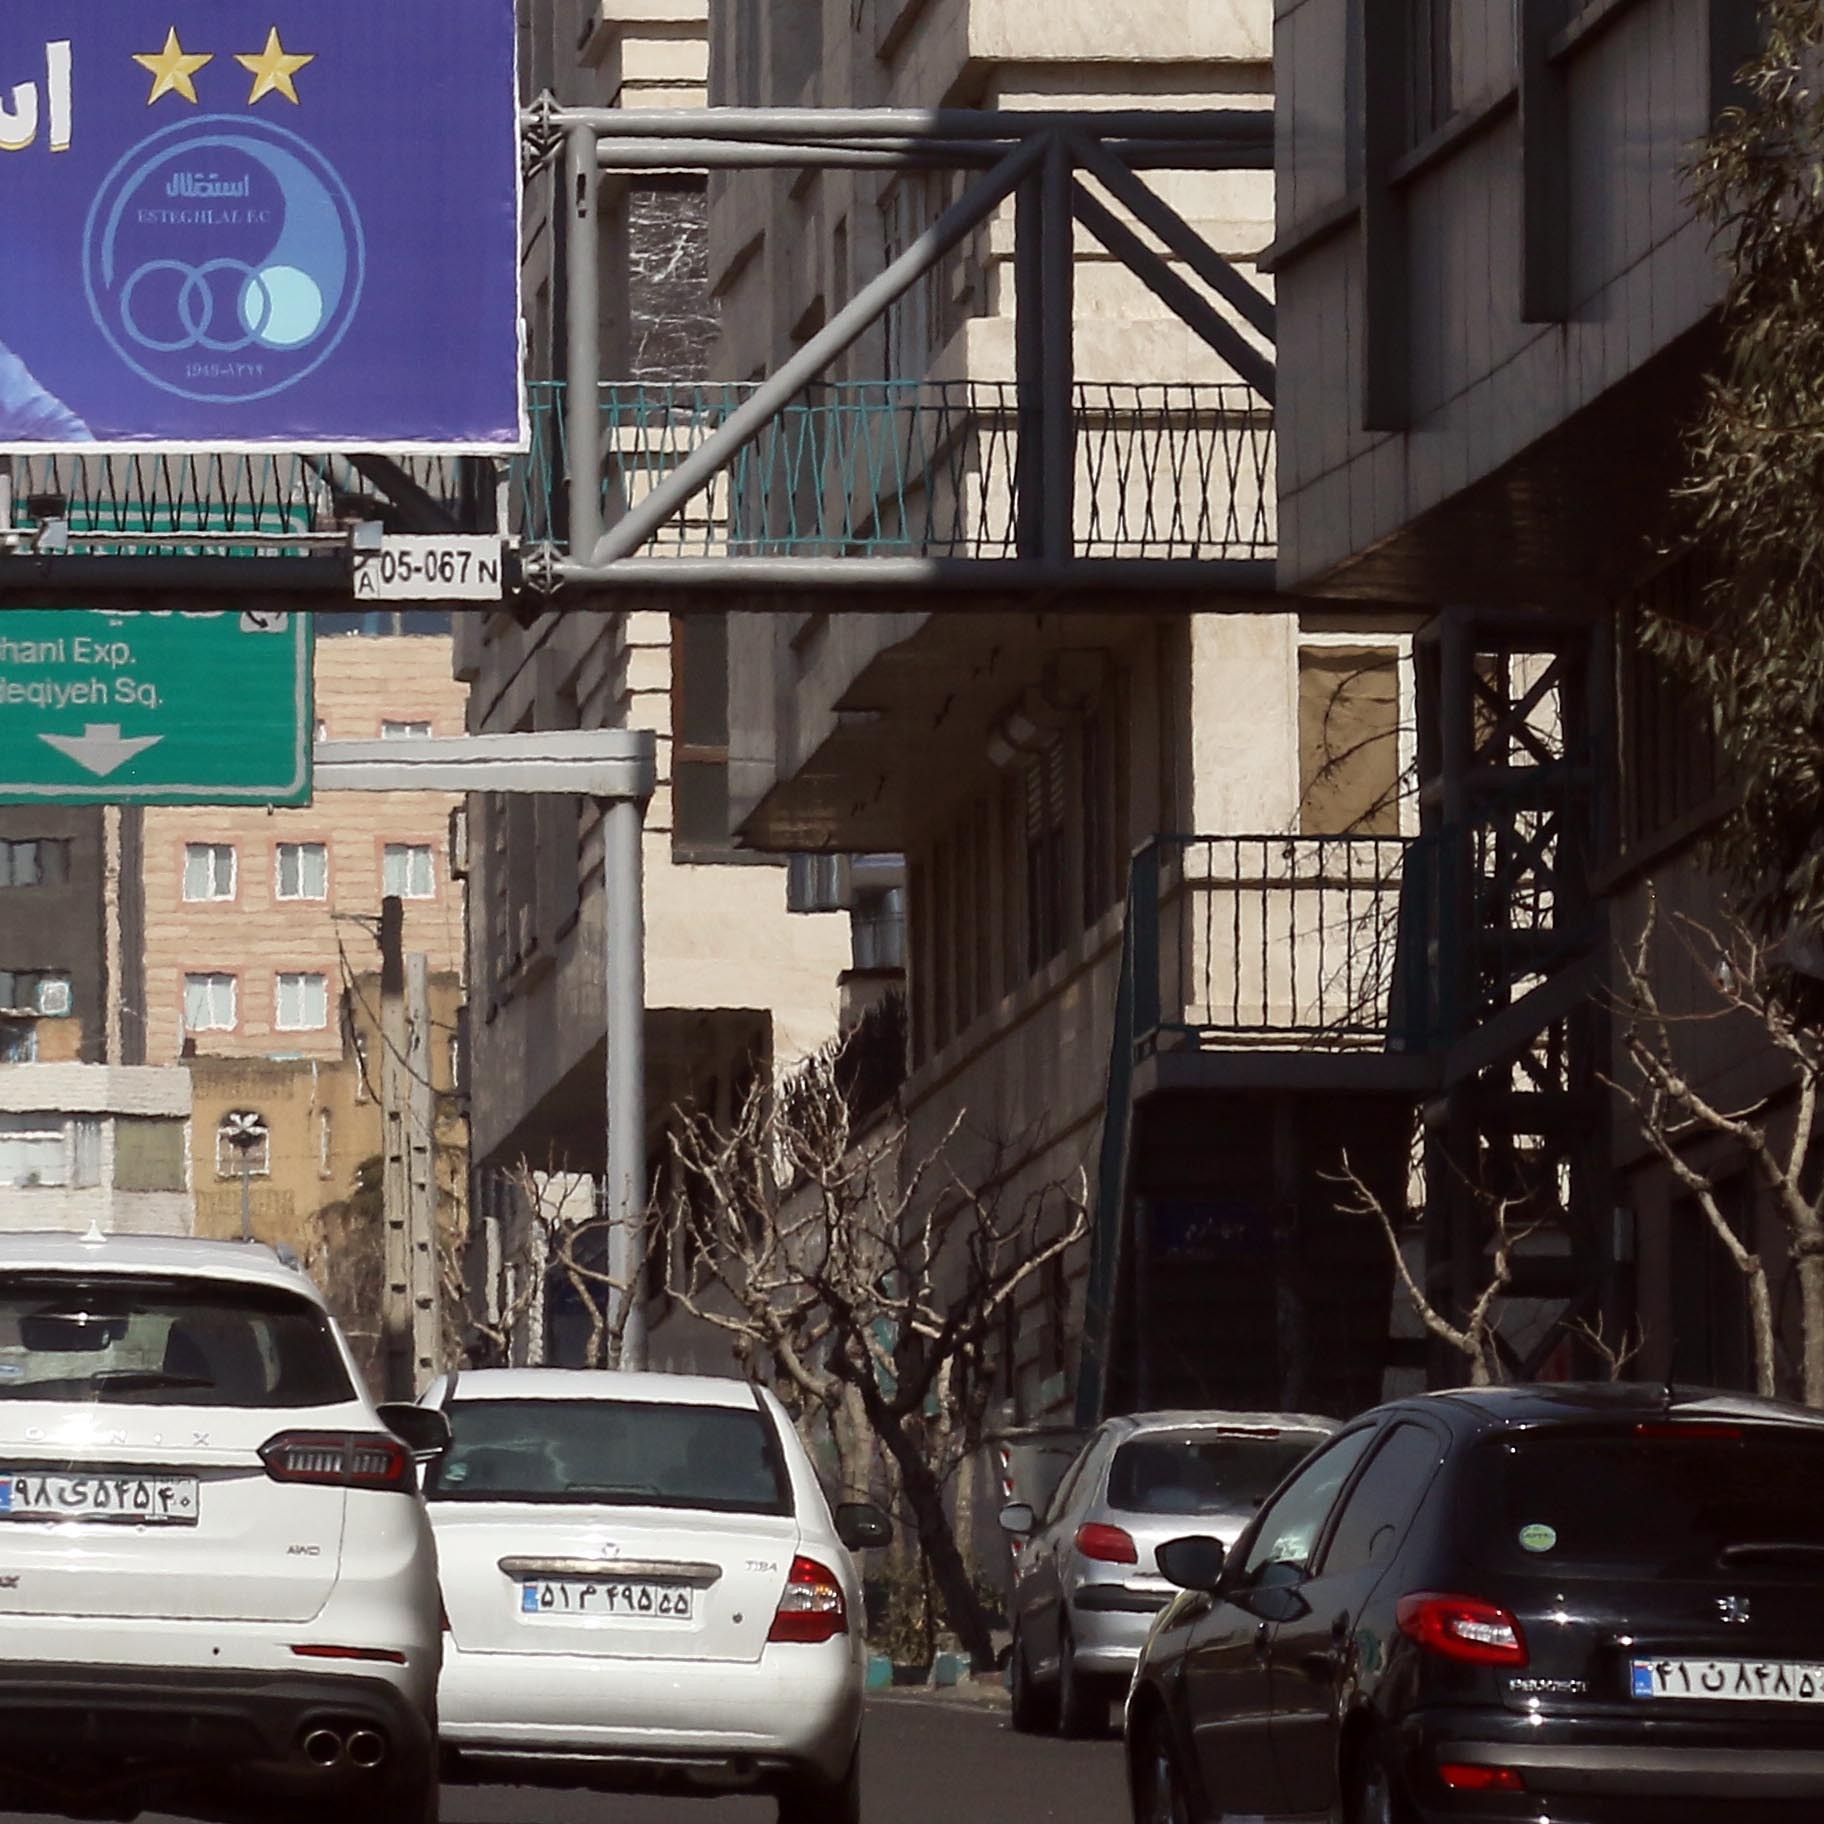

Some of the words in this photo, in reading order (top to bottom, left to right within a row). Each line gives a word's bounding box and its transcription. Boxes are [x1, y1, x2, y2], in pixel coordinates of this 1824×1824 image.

[380, 550, 472, 584] 05-067
[478, 560, 498, 583] N
[73, 639, 136, 669] Exp.
[115, 679, 164, 707] Sq.
